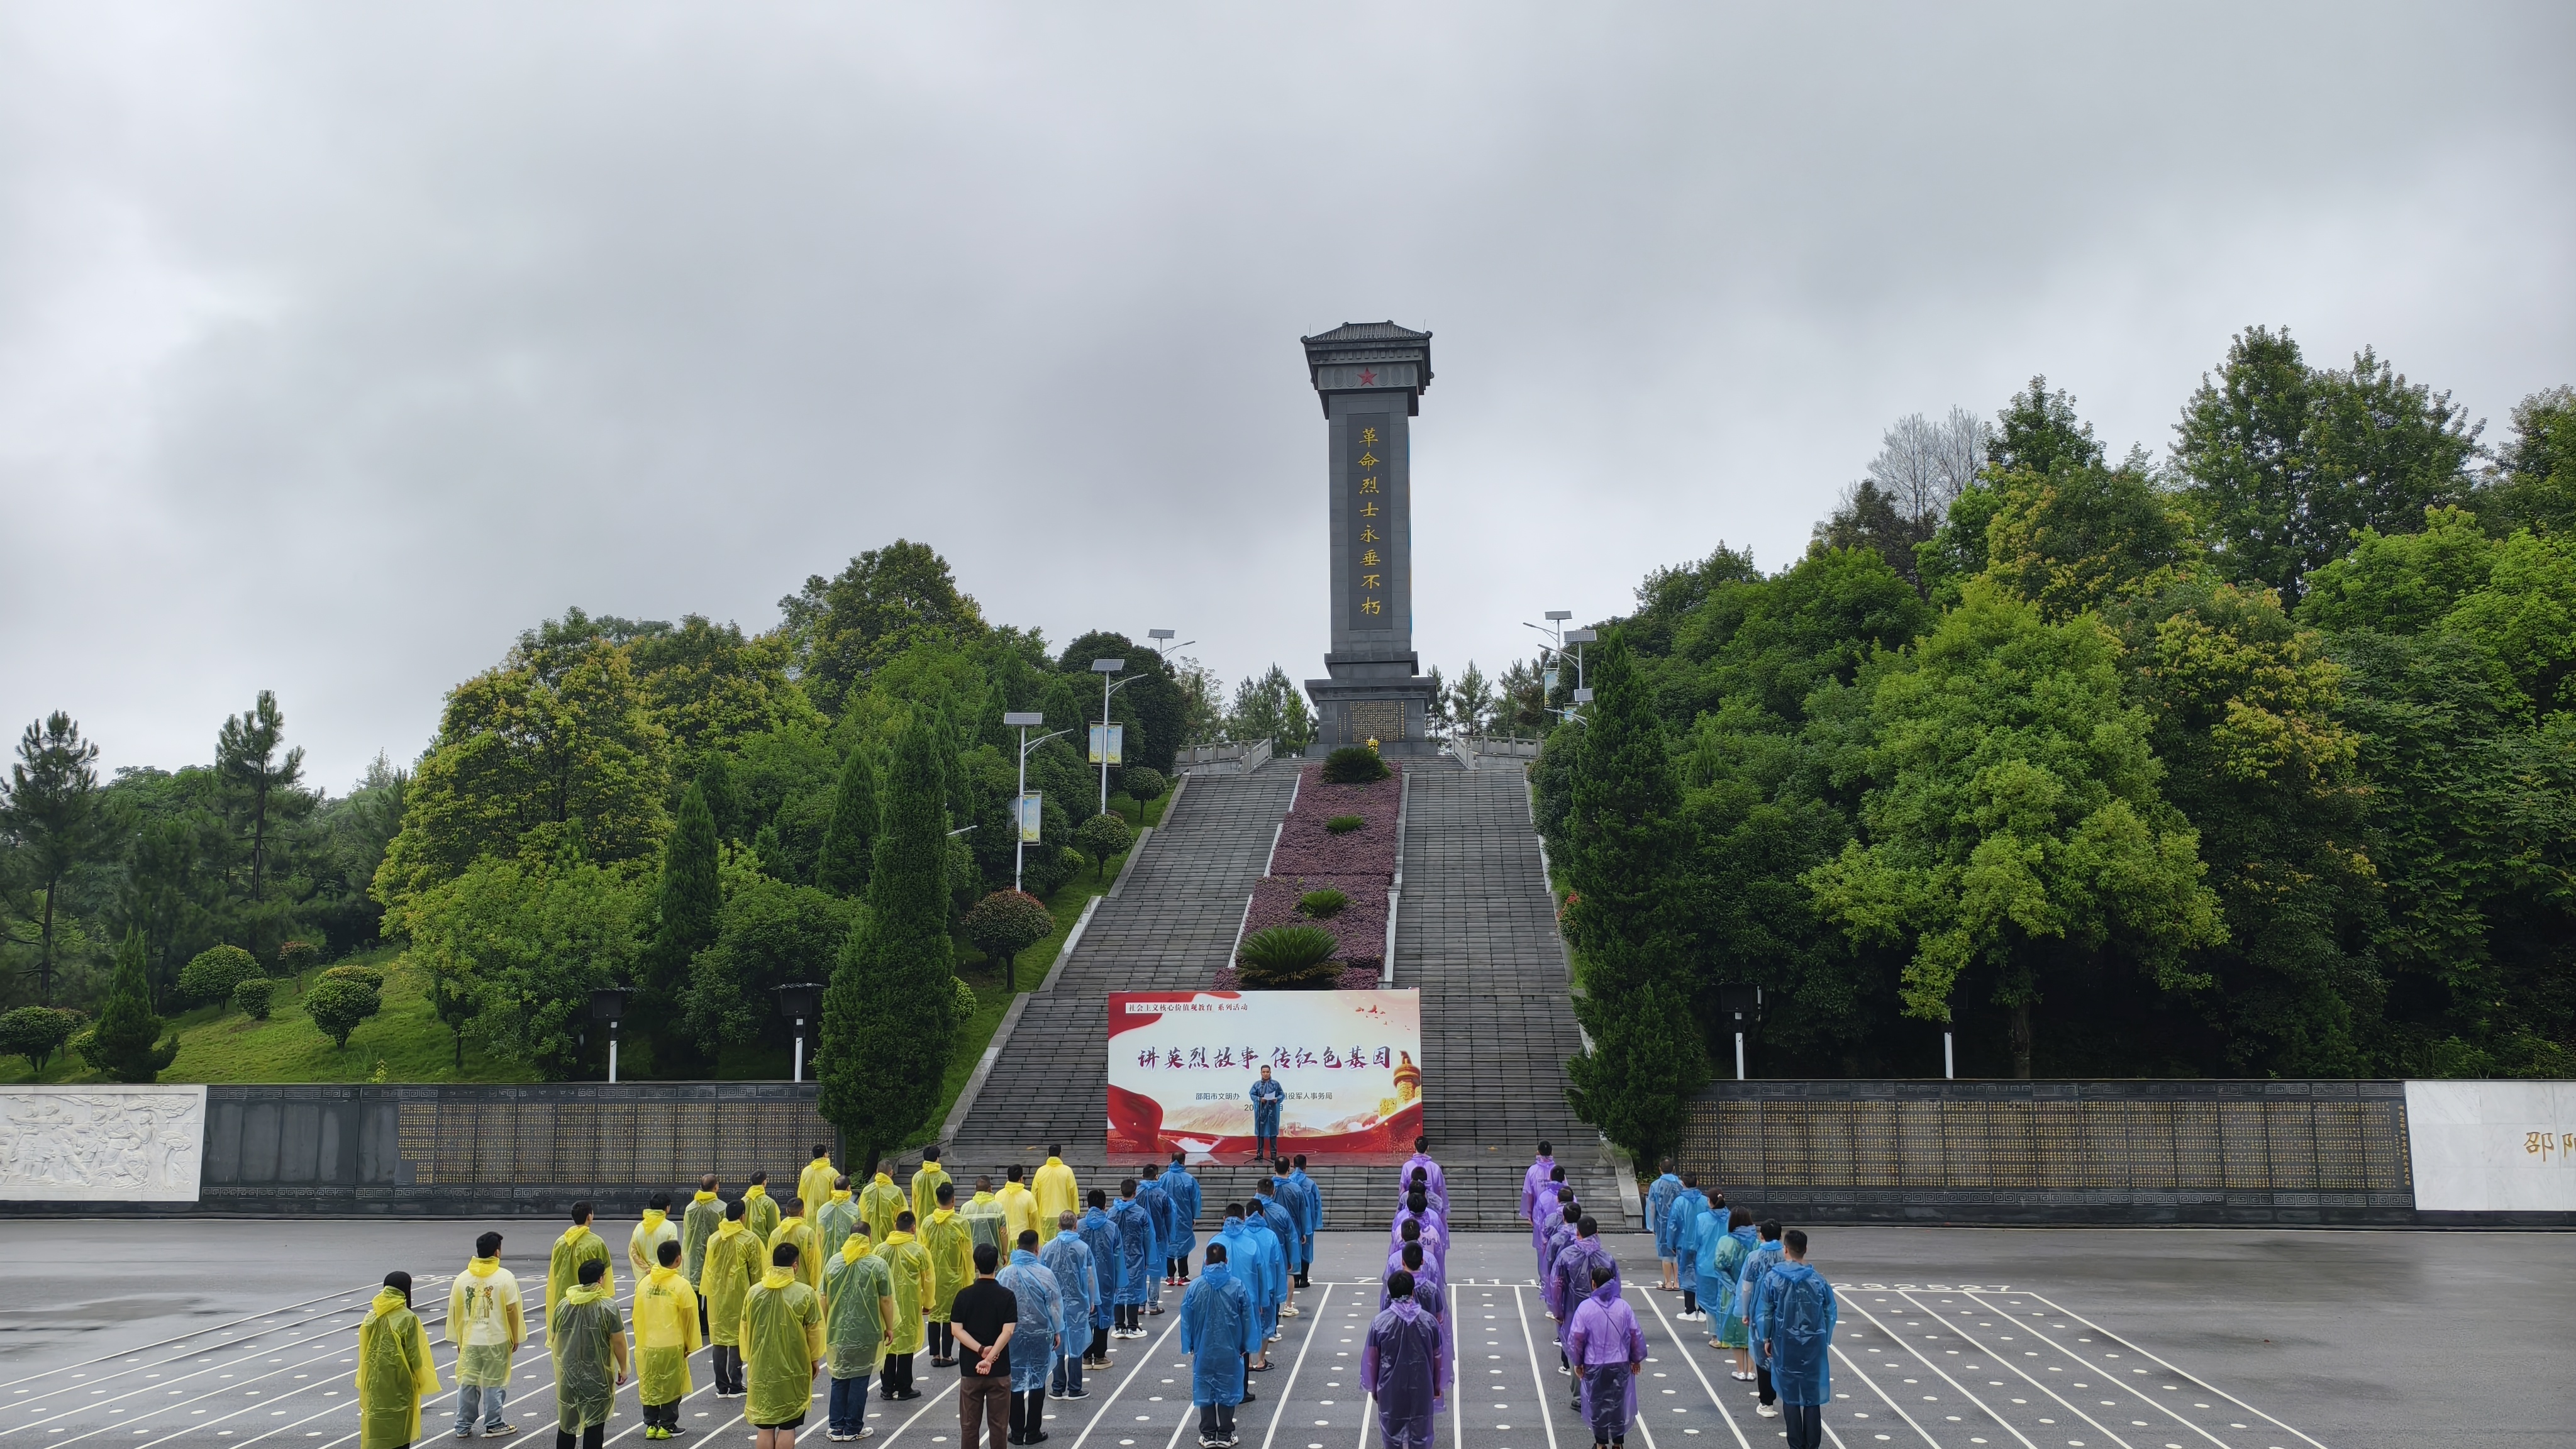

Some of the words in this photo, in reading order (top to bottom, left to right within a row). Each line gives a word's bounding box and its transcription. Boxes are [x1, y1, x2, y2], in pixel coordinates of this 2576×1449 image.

[1358, 427, 1380, 614] 革命烈士永垂不朽
[1129, 1003, 1213, 1011] 社会主义核心价值观教育
[1138, 1046, 1258, 1070] 讲英烈故事
[1270, 1045, 1391, 1069] 传红色基因
